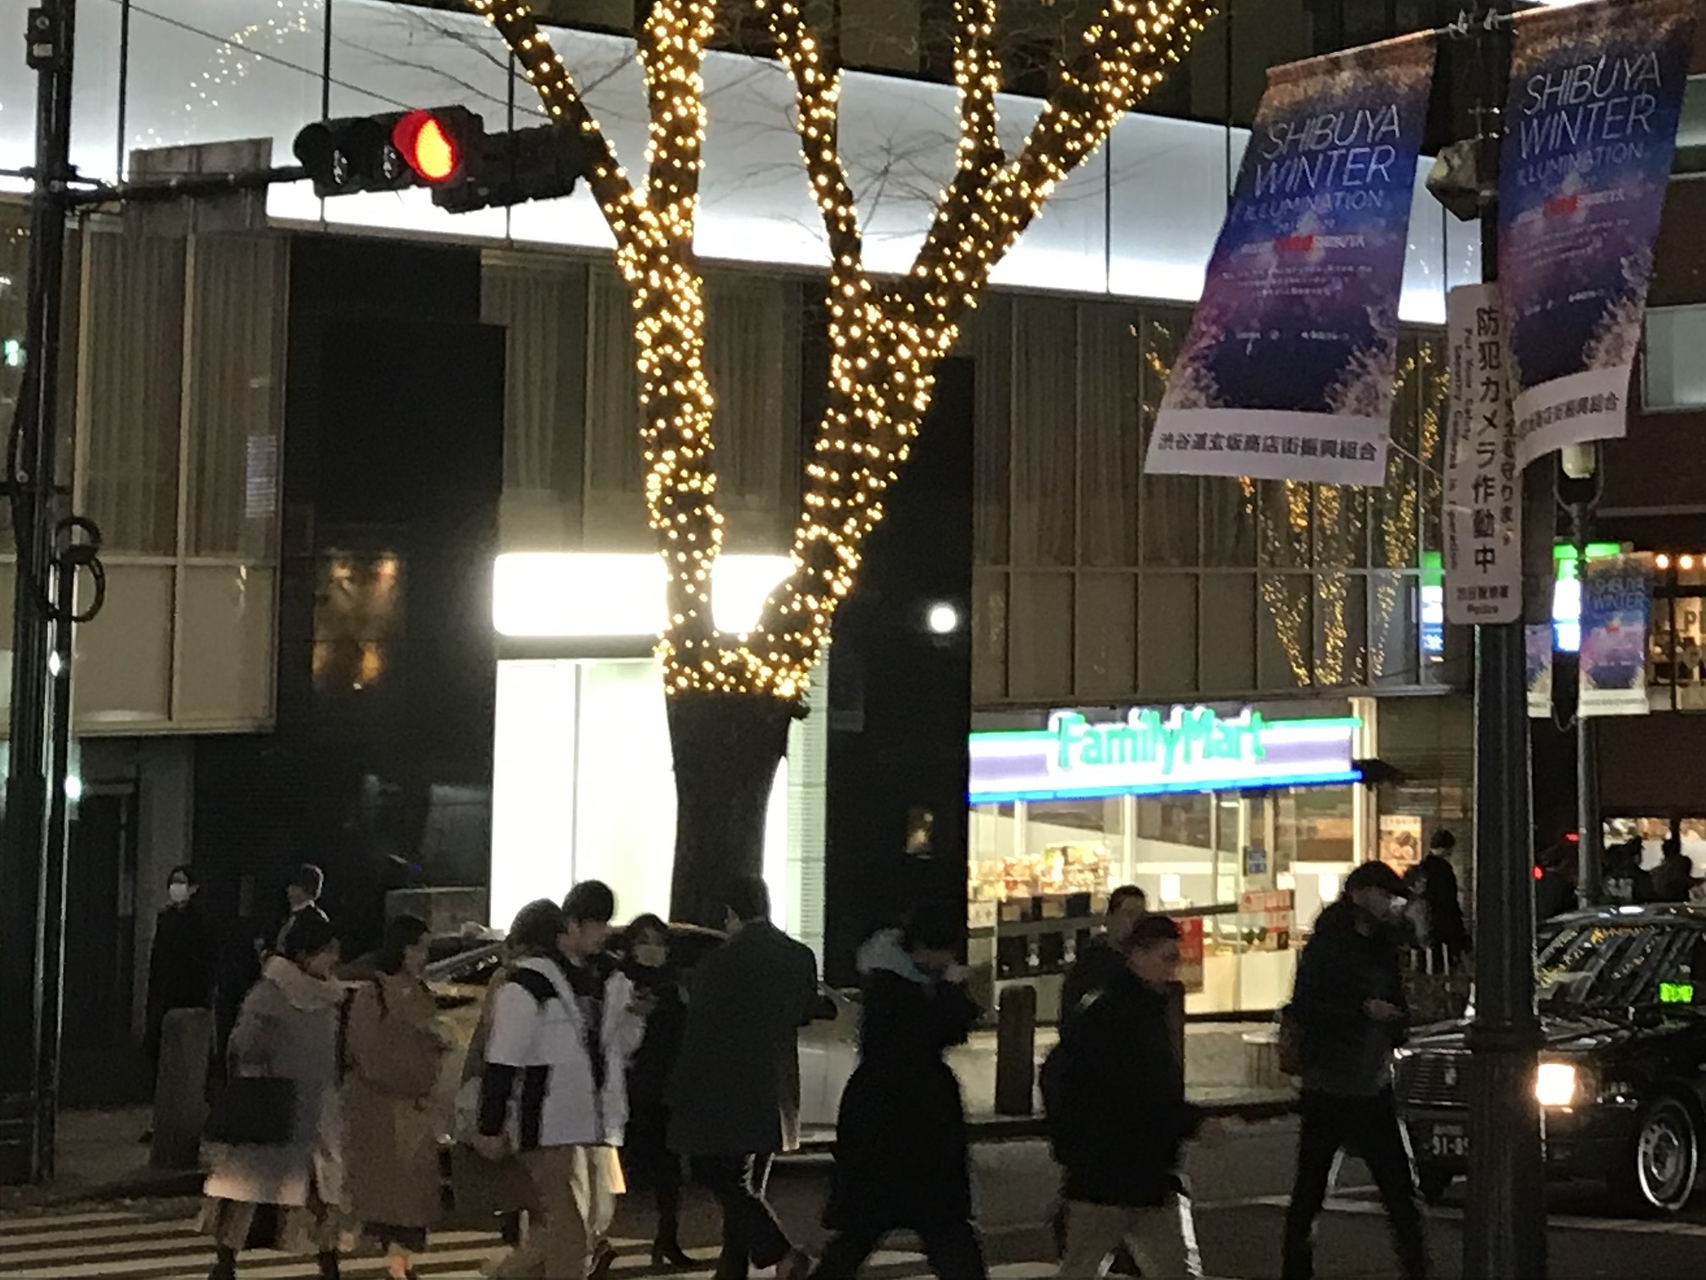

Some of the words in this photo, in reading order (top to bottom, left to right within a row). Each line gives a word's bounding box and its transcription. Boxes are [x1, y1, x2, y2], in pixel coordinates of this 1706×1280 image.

[1523, 52, 1662, 116] SHIBUYA
[1261, 104, 1401, 160] SHIBUYA
[1520, 96, 1657, 159] WINTER
[1254, 144, 1397, 198] WINTER
[1157, 431, 1378, 462] 渋谷道玄坂商店街振興組合
[1472, 305, 1501, 574] 防犯カメラ作動中
[1054, 706, 1264, 774] FamilyMart
